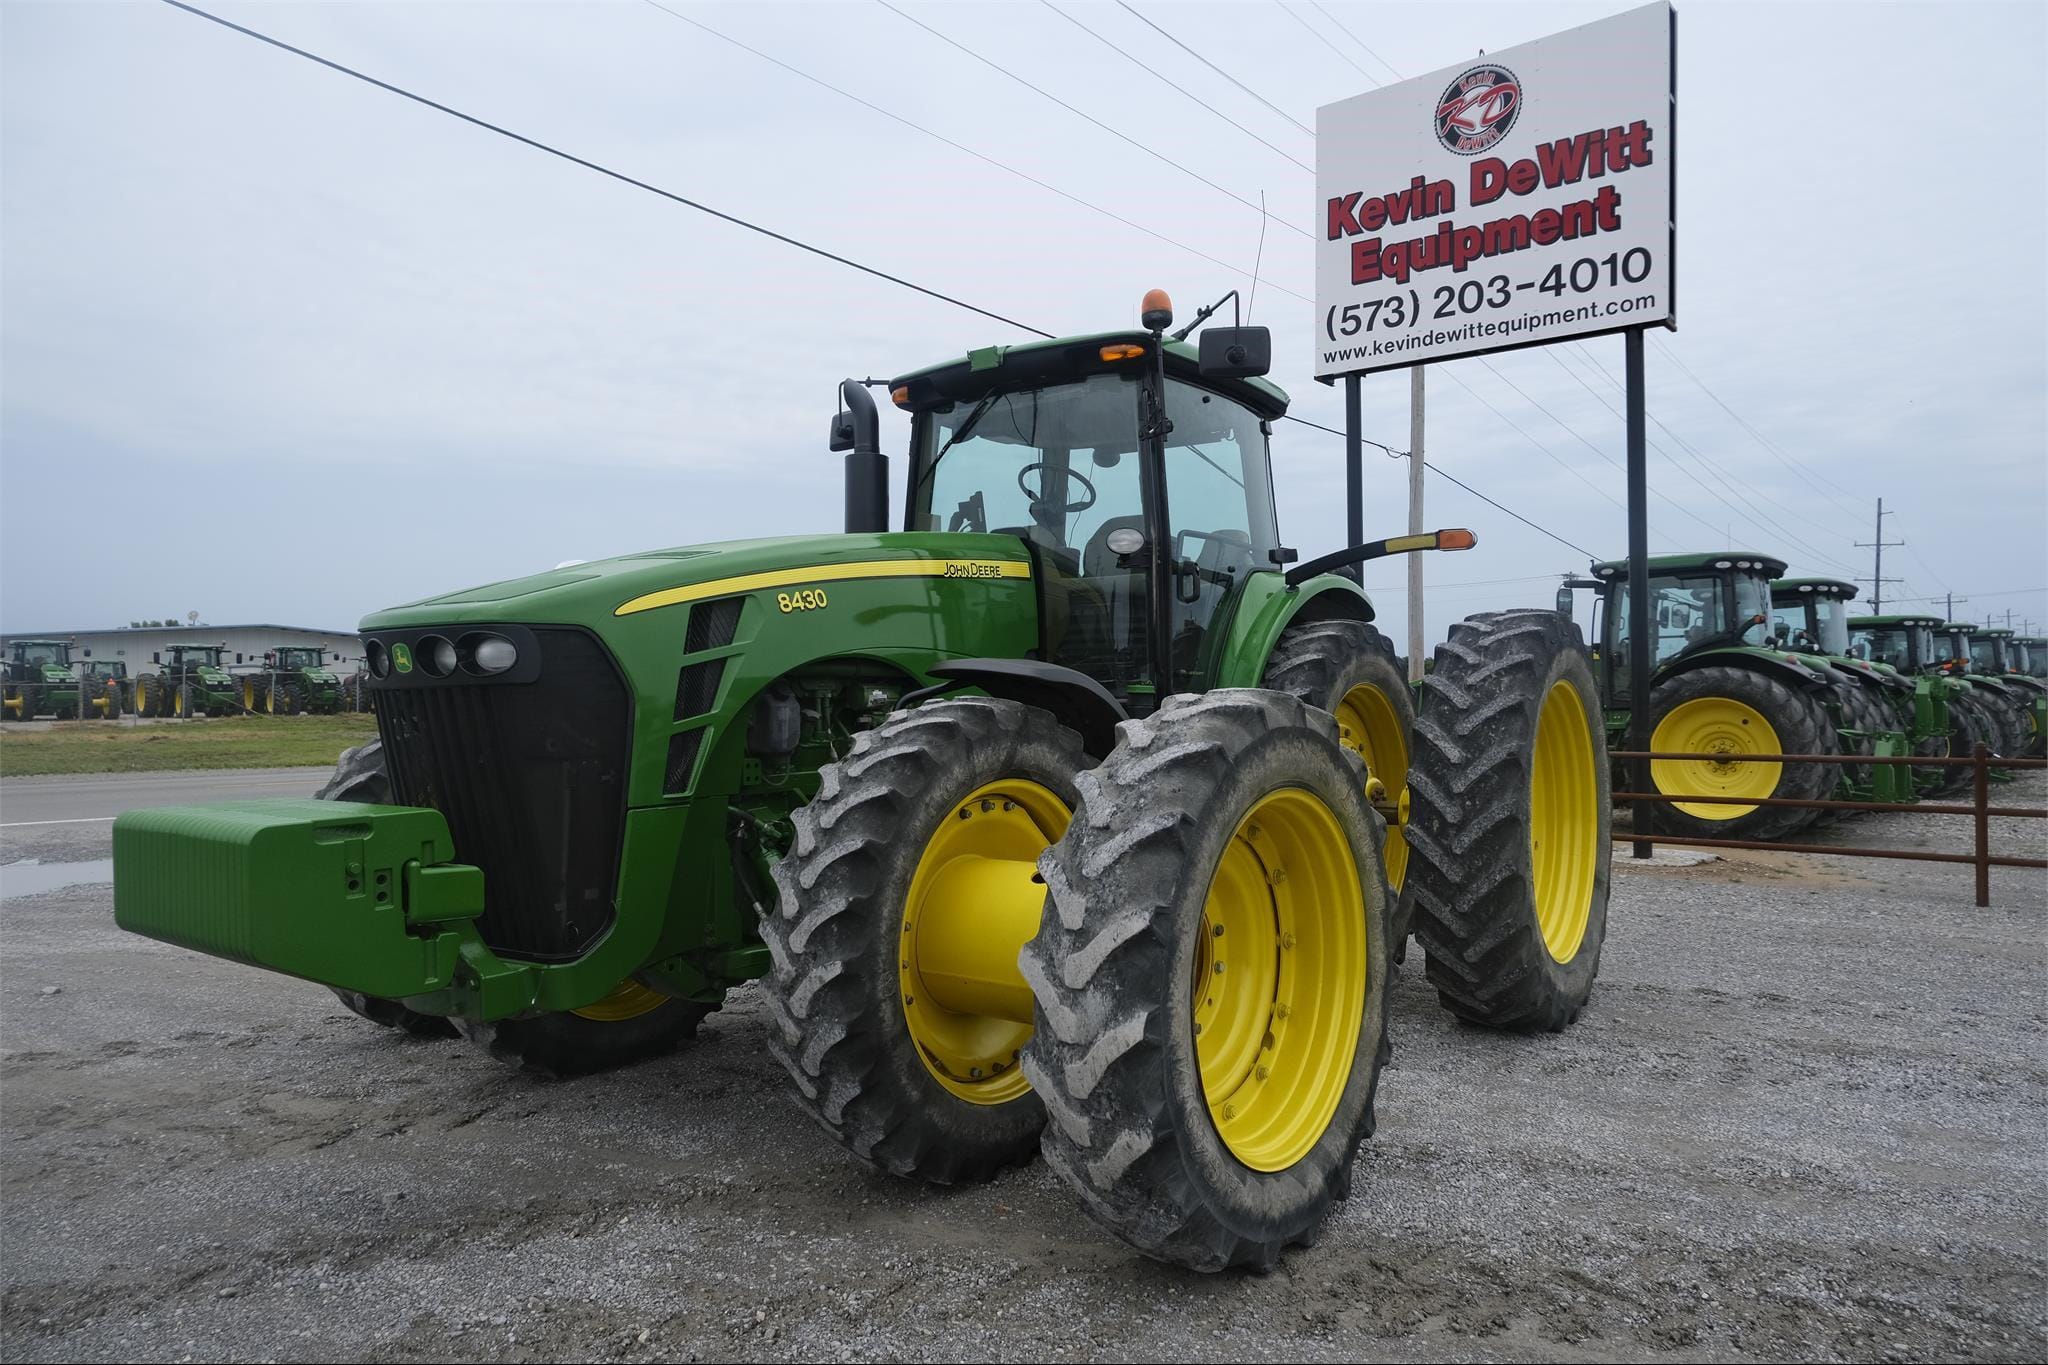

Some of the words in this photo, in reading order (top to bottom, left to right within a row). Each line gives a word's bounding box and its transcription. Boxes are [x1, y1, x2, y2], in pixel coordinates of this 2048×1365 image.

[1459, 70, 1496, 91] Kevin
[1328, 175, 1455, 241] Kevin
[1470, 119, 1653, 207] DeWitt
[1351, 185, 1621, 285] Equipment
[1324, 294, 1656, 363] www.kevindewittequipment.com
[1325, 289, 1420, 342] (573)
[1433, 247, 1652, 320] 203-4010
[777, 588, 828, 614] 8430
[944, 562, 970, 577] JOHN
[970, 562, 1002, 578] DEERE
